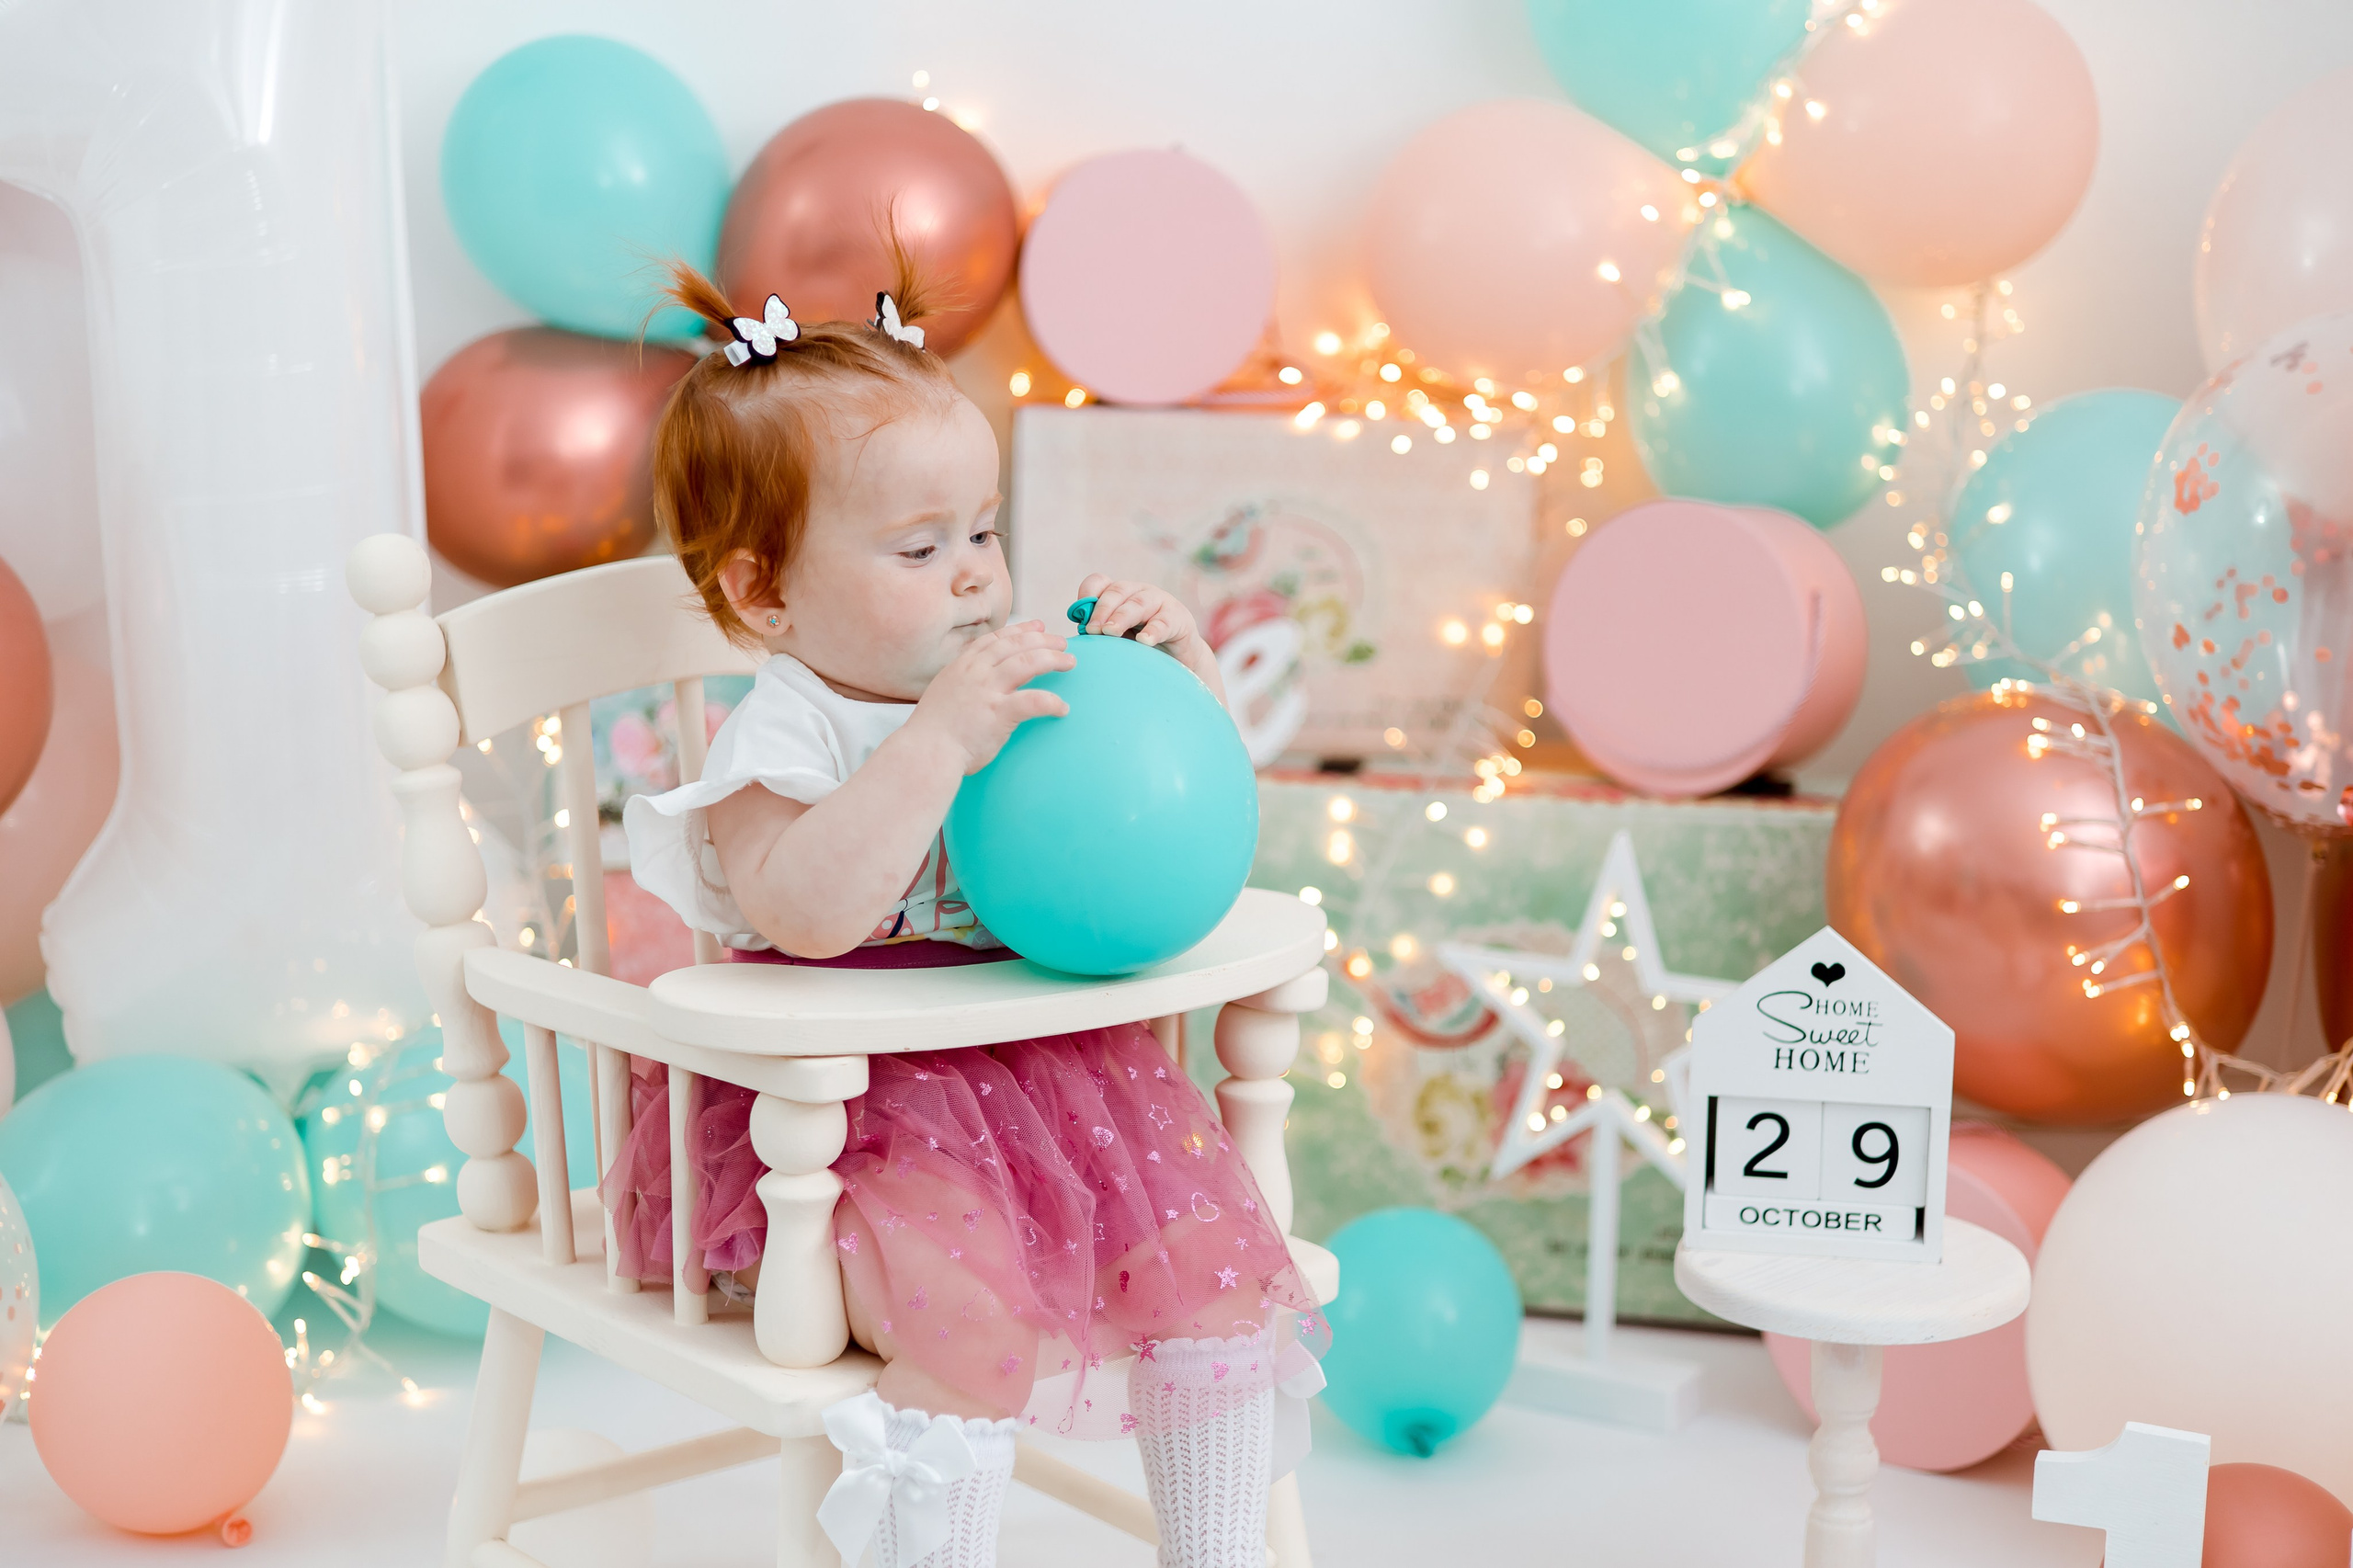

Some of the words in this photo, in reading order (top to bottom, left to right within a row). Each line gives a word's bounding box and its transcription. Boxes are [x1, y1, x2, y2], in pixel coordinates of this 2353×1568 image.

[1756, 991, 1883, 1047] Sweet
[1815, 999, 1879, 1017] HOME
[1774, 1048, 1870, 1074] HOME
[1740, 1206, 1882, 1232] OCTOBER
